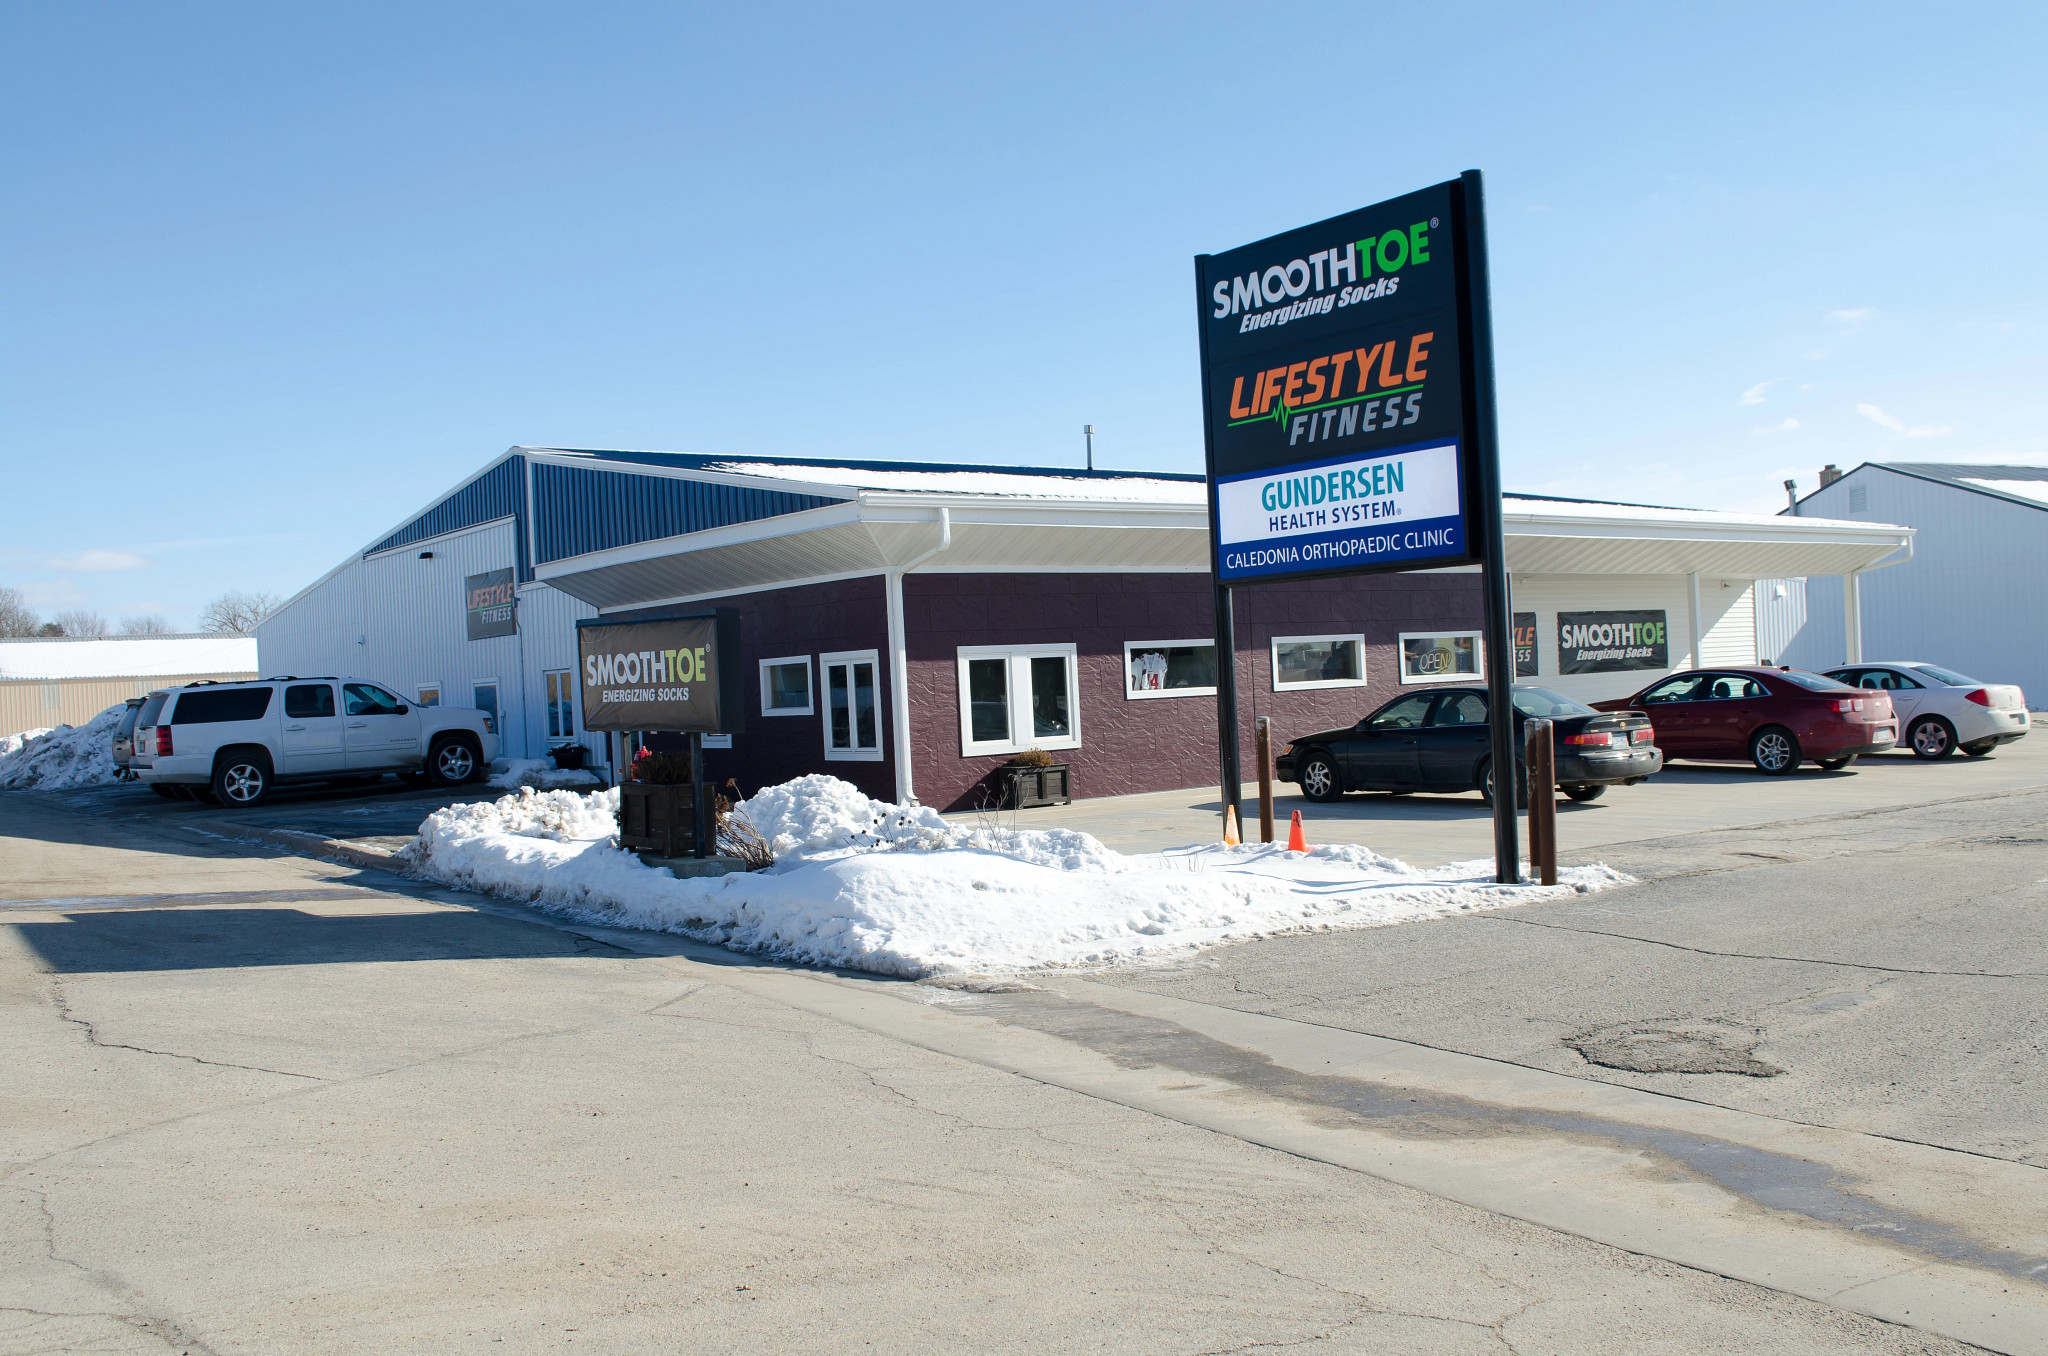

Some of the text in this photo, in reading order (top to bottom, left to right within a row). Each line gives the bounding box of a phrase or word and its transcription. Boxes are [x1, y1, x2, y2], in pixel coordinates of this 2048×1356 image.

[1239, 277, 1400, 333] Energizing Socks
[1229, 331, 1434, 419] LIFESTYLE
[1289, 392, 1423, 446] FITNESS
[1261, 461, 1404, 511] GUNDERSEN
[1269, 509, 1326, 532] HEALTH
[1226, 528, 1454, 569] CALEDONIA ORTHOPAEDIC CLINIC
[467, 582, 513, 610] LIFESTYLE
[482, 607, 511, 624] FITNESS
[1561, 622, 1665, 649] SMOOTHTOE
[1420, 652, 1450, 670] OPEN
[1576, 647, 1653, 661] Energizing Socks
[602, 687, 690, 703] ENERGIZING SOCKS
